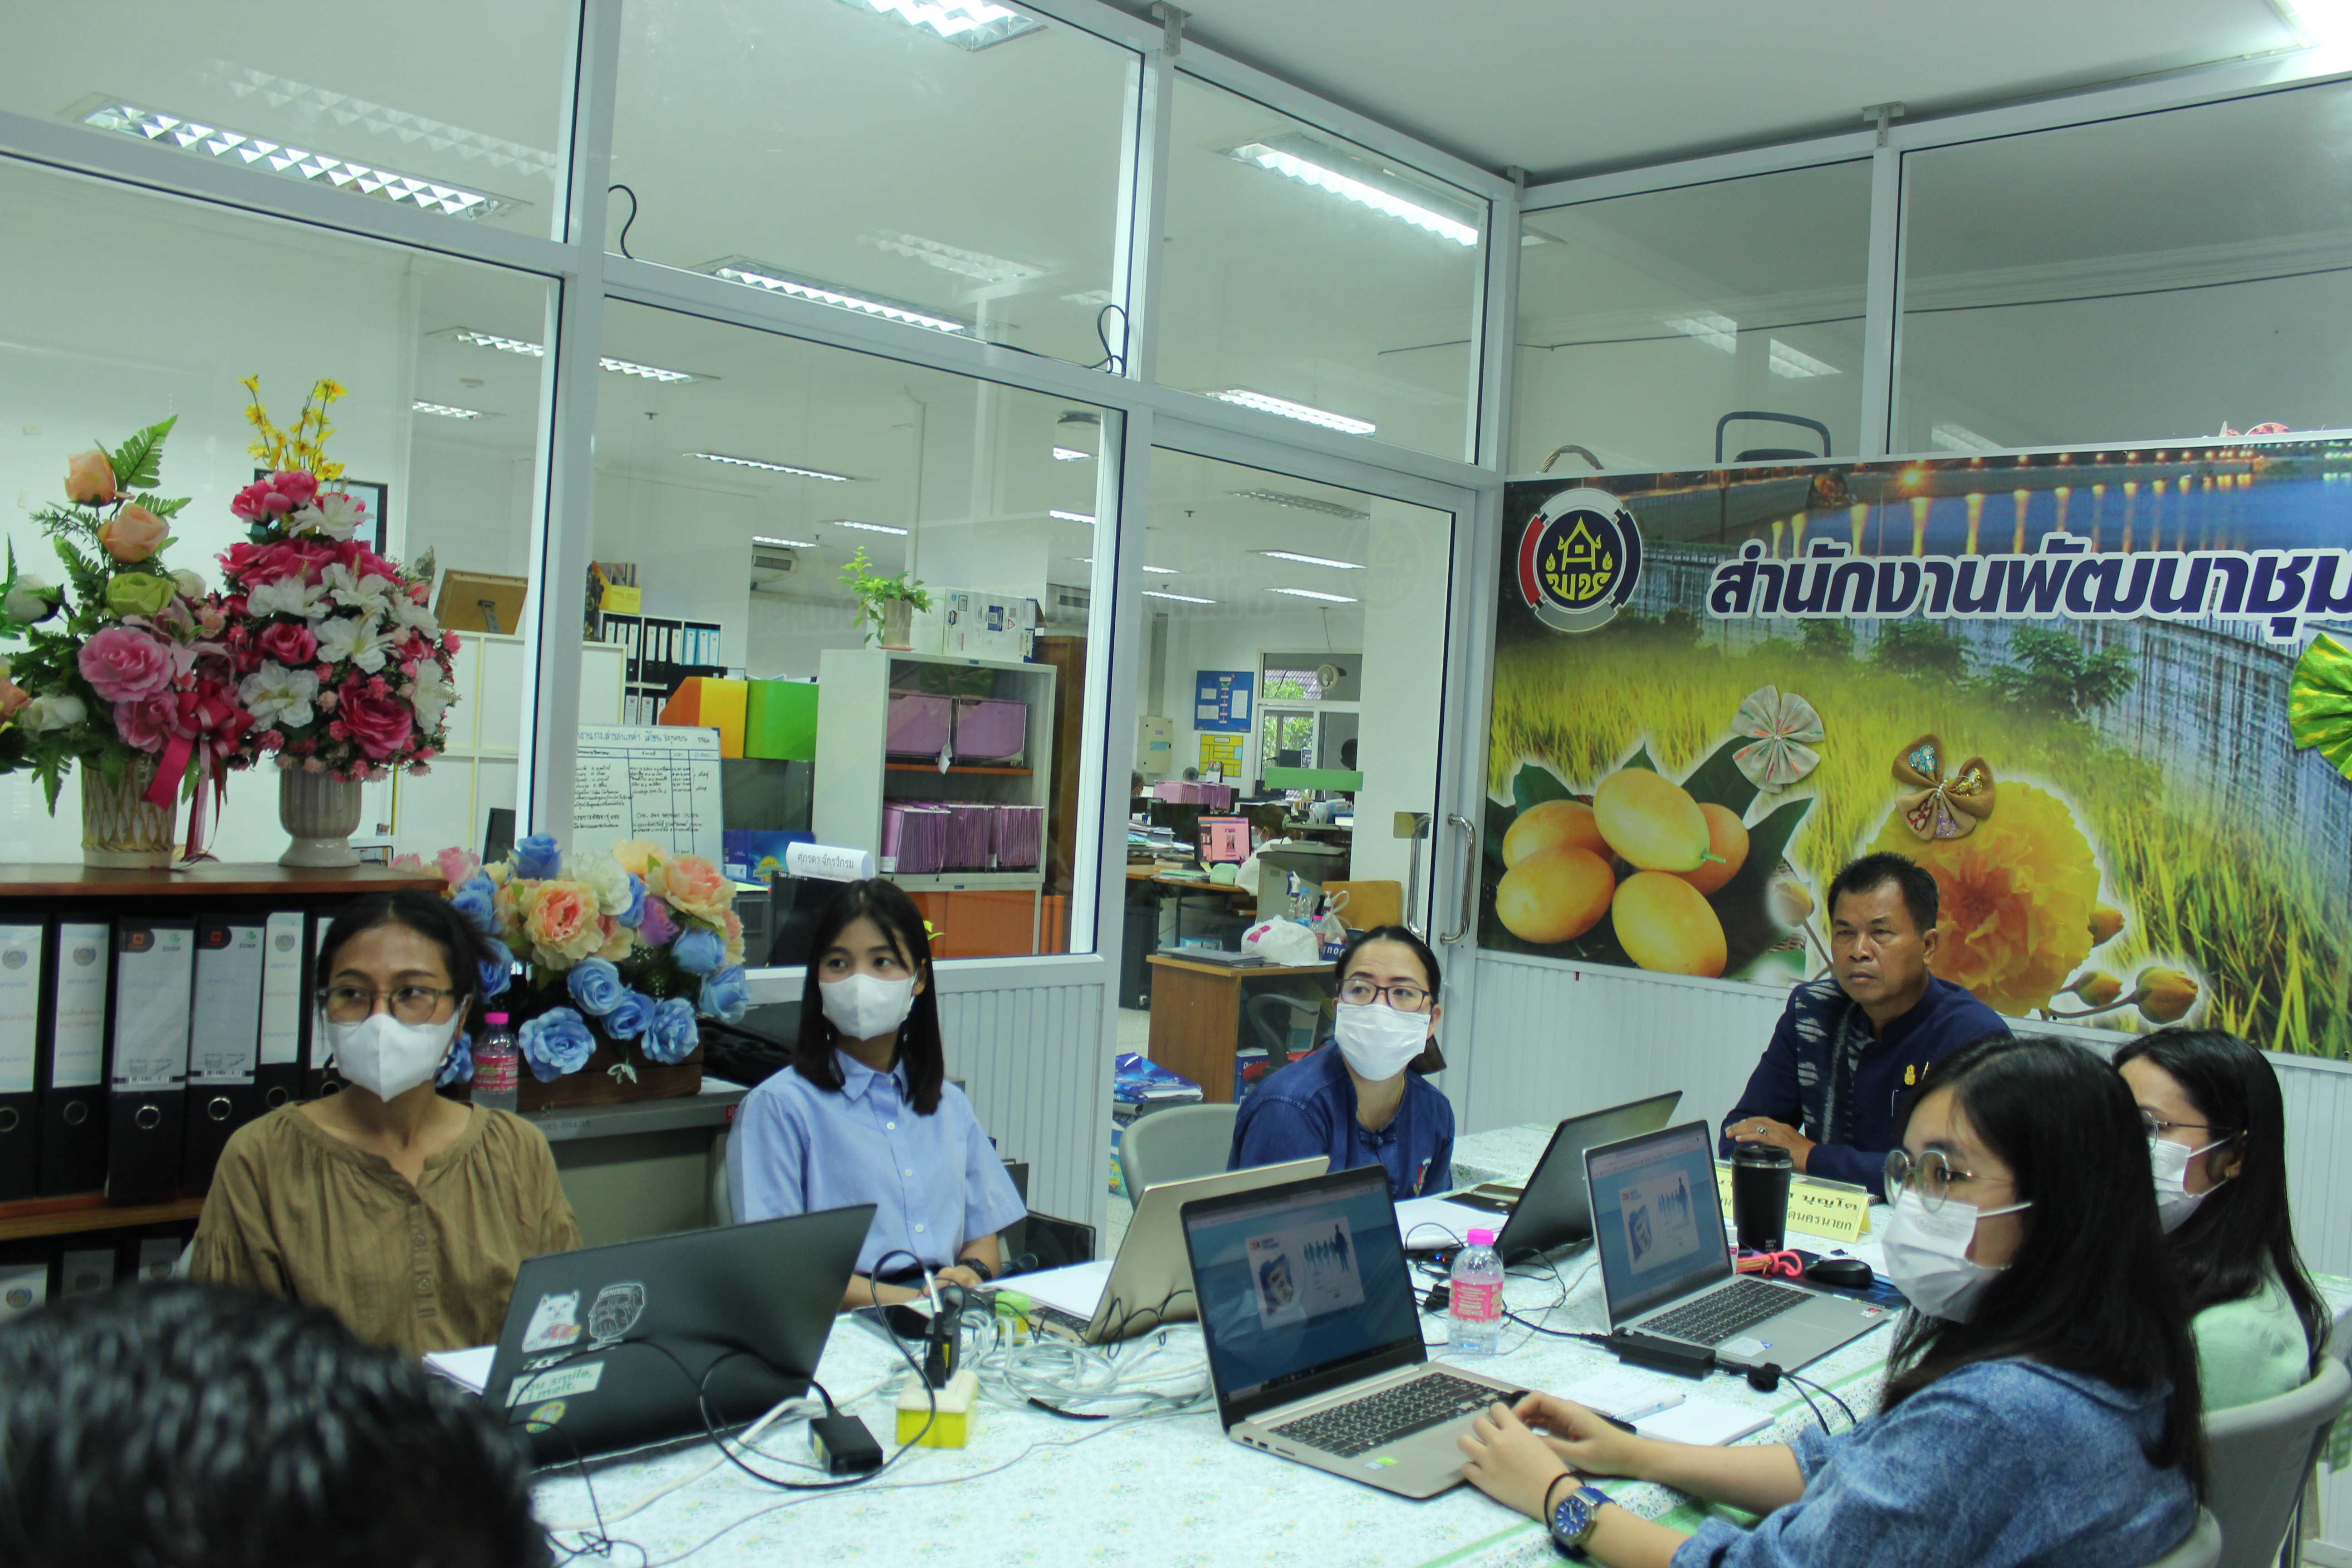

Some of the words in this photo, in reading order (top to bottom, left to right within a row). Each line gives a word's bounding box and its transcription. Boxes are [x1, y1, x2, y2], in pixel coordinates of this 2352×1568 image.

[1788, 1206, 1852, 1231] ดนครนายก
[550, 1368, 592, 1386] smile,
[537, 1382, 575, 1400] melt.
